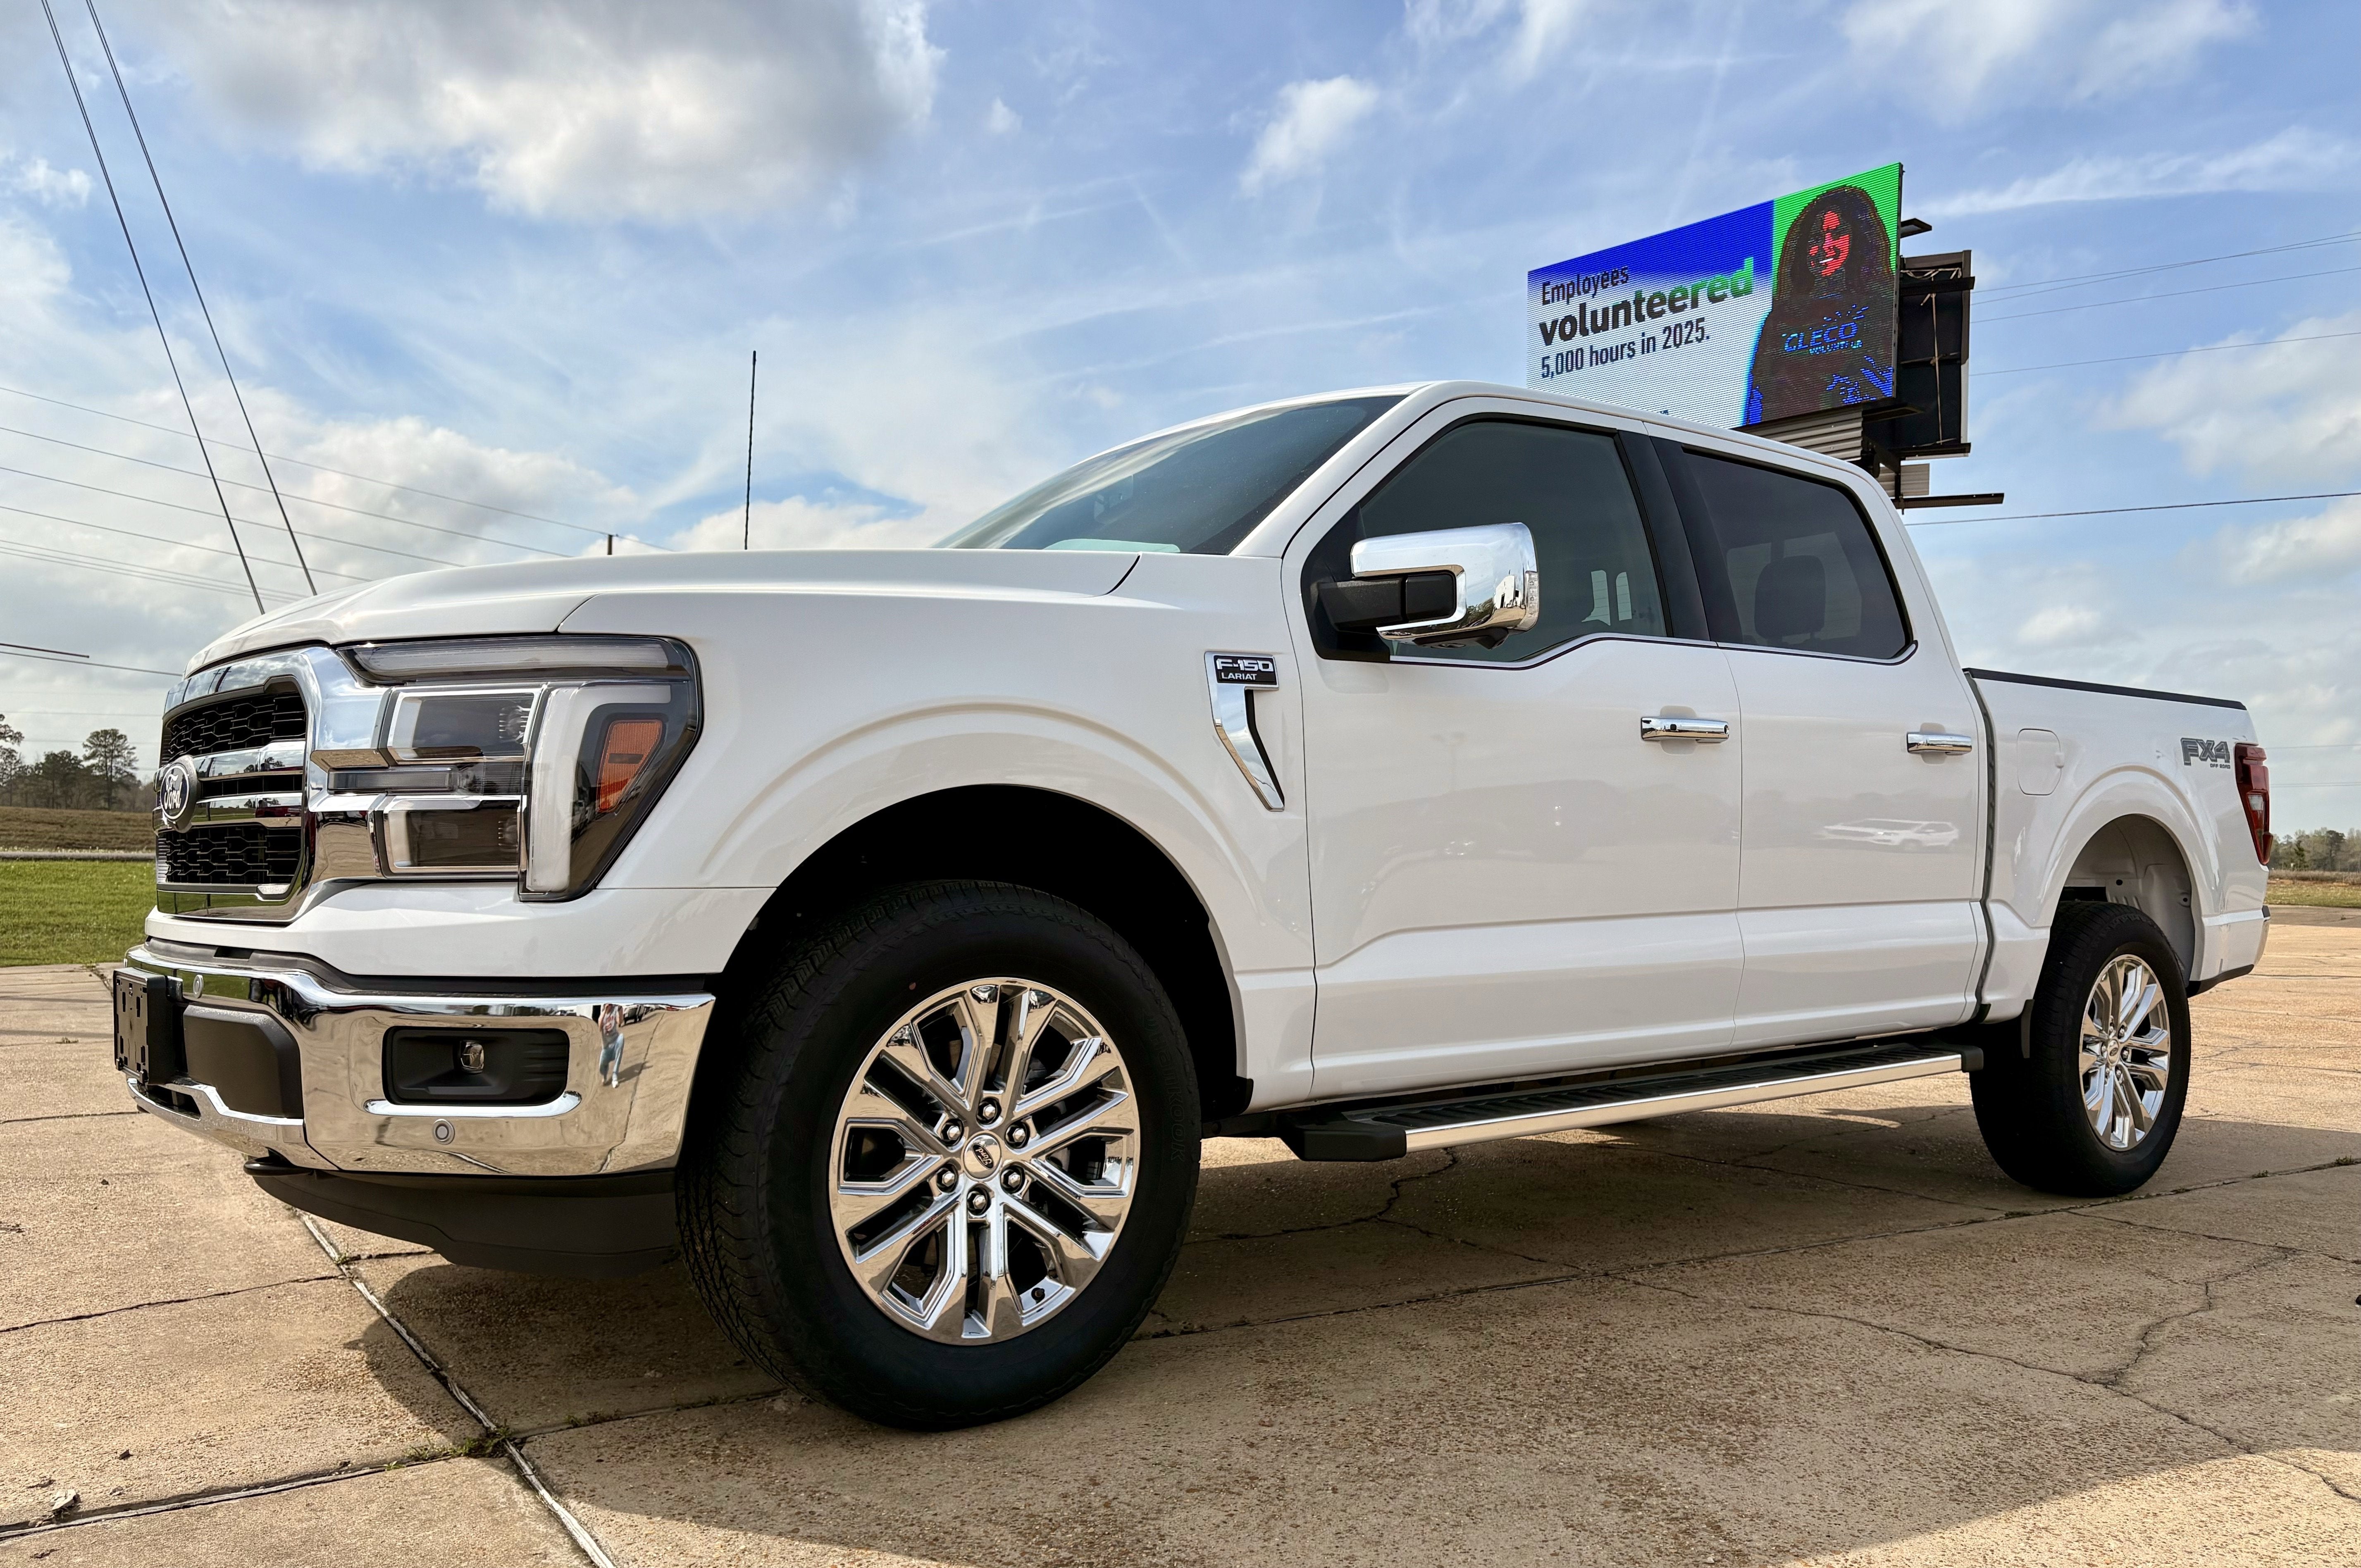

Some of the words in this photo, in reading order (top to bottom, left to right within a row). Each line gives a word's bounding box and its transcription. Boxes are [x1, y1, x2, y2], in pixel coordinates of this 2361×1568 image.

[1539, 257, 1754, 346] volunteered
[1542, 266, 1629, 305] Employees
[1542, 348, 1584, 379] 5,000
[1590, 341, 1636, 367] hours
[1641, 332, 1656, 355] in
[1663, 317, 1710, 349] 2025.
[1784, 322, 1858, 352] CLECO
[1216, 658, 1274, 672] F-150
[1221, 672, 1257, 680] LARIAT
[2180, 737, 2230, 766] FX4
[164, 774, 183, 810] Ford
[1148, 1034, 1186, 1163] Hankook
[975, 1147, 992, 1165] Ford
